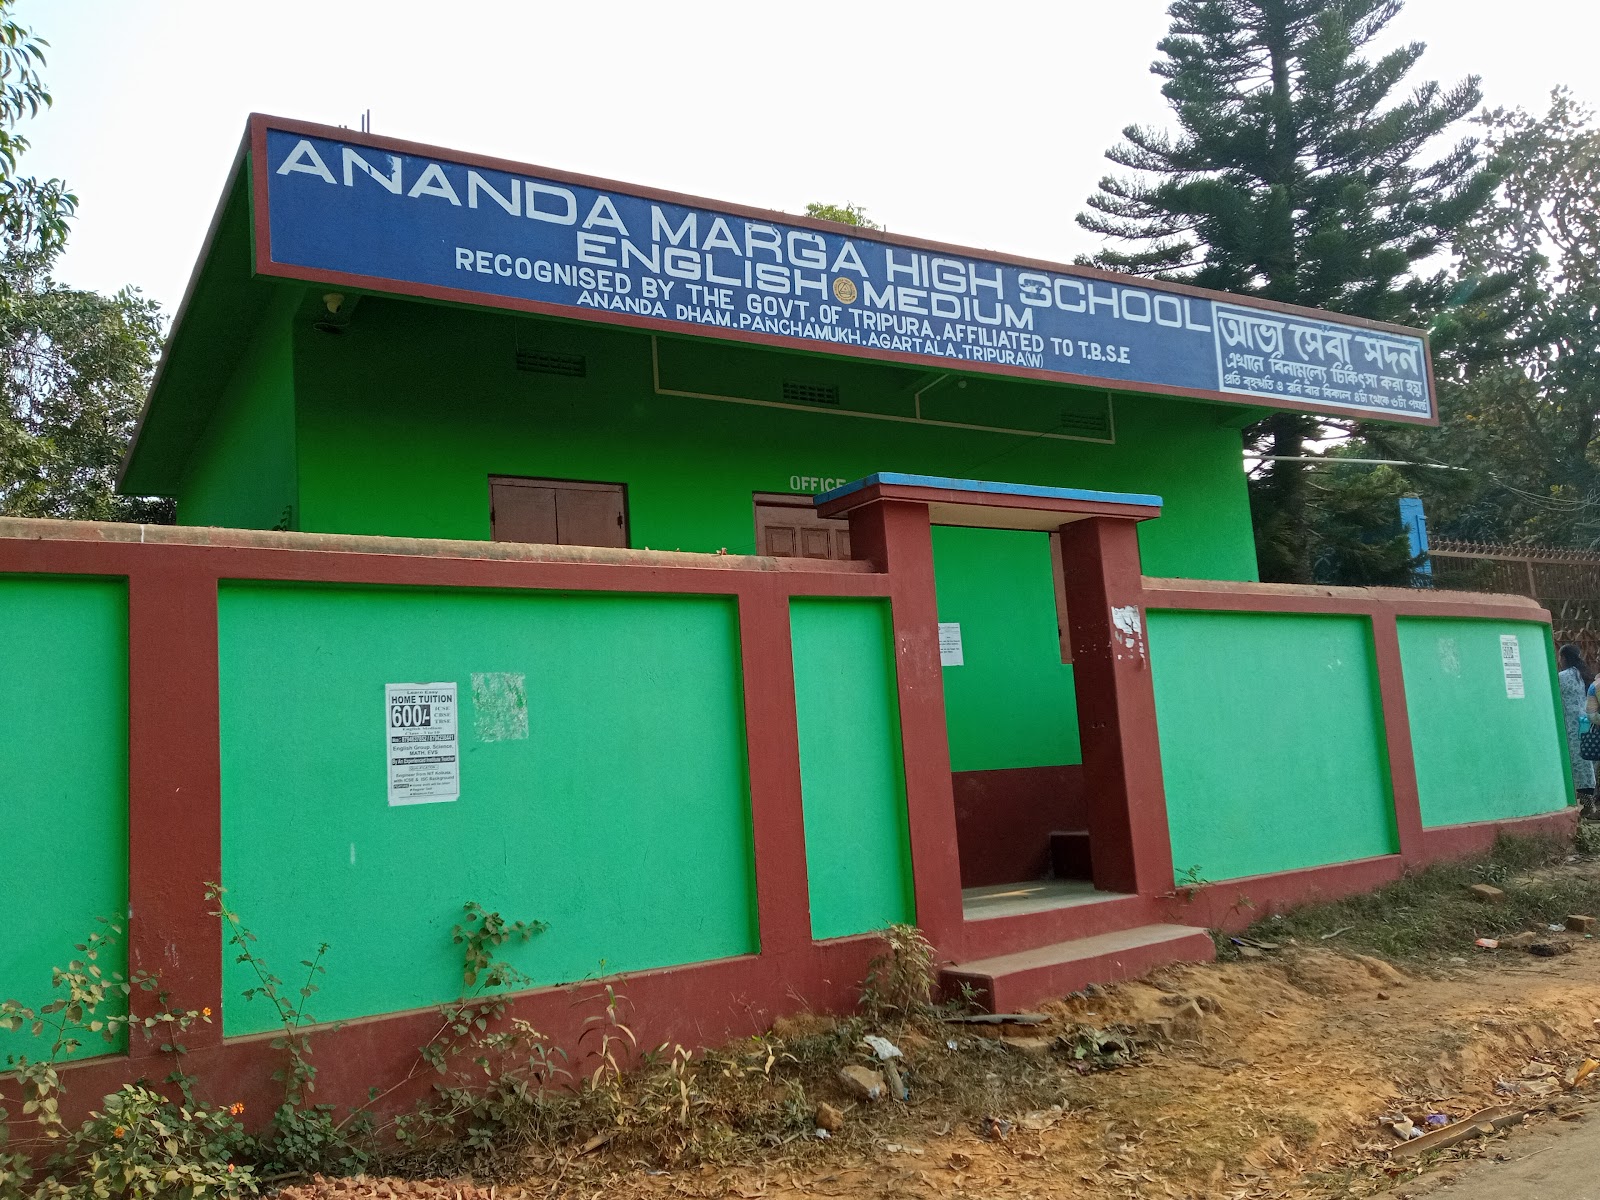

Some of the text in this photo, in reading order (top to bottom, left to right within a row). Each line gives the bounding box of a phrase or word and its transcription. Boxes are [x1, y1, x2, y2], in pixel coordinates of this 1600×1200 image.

[276, 139, 1212, 333] ANANDA MARGA HIGH SCHOOL
[455, 247, 632, 294] RECOGNISED
[642, 277, 675, 301] BY
[686, 283, 735, 310] THE
[1050, 337, 1074, 357] TO
[1078, 341, 1131, 364] T.B.S.E
[577, 231, 828, 300] ENGLISH
[863, 280, 1034, 331] MEDIUM
[577, 290, 667, 318] ANANDA
[1218, 311, 1418, 376] আভা সেবা সদন
[1224, 372, 1241, 386] প্রতি
[1276, 381, 1283, 391] ও
[1286, 379, 1302, 394] রবি
[1304, 384, 1320, 397] বার
[1322, 383, 1351, 400] বিকাল
[1369, 393, 1390, 406] থেকে
[1226, 350, 1423, 399] এখানে বিনামূল্যে চিকিৎসা করা হয়
[391, 695, 452, 704] HOME TUITION
[392, 705, 430, 727] 600/-
